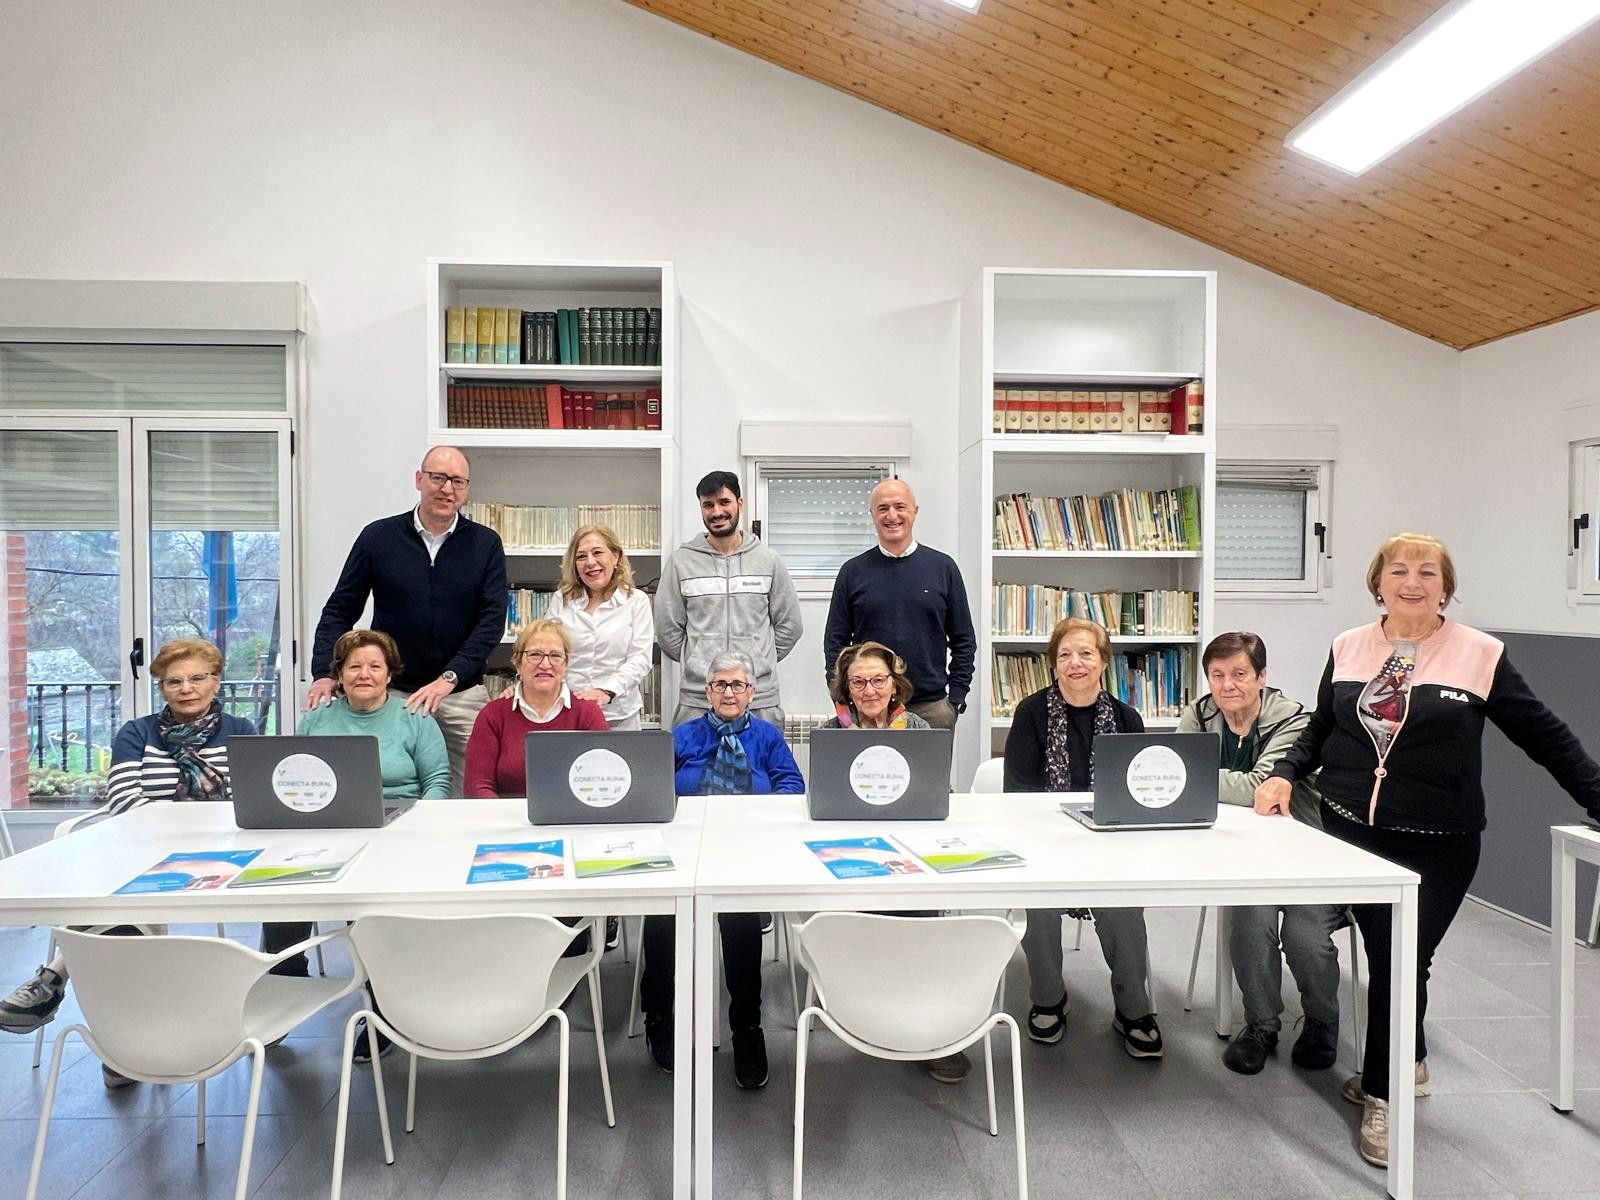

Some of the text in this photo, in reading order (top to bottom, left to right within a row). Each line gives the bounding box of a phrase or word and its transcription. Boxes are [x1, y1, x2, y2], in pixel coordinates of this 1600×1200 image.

[1440, 690, 1469, 702] FILA
[277, 780, 332, 788] CONECTA RURAL
